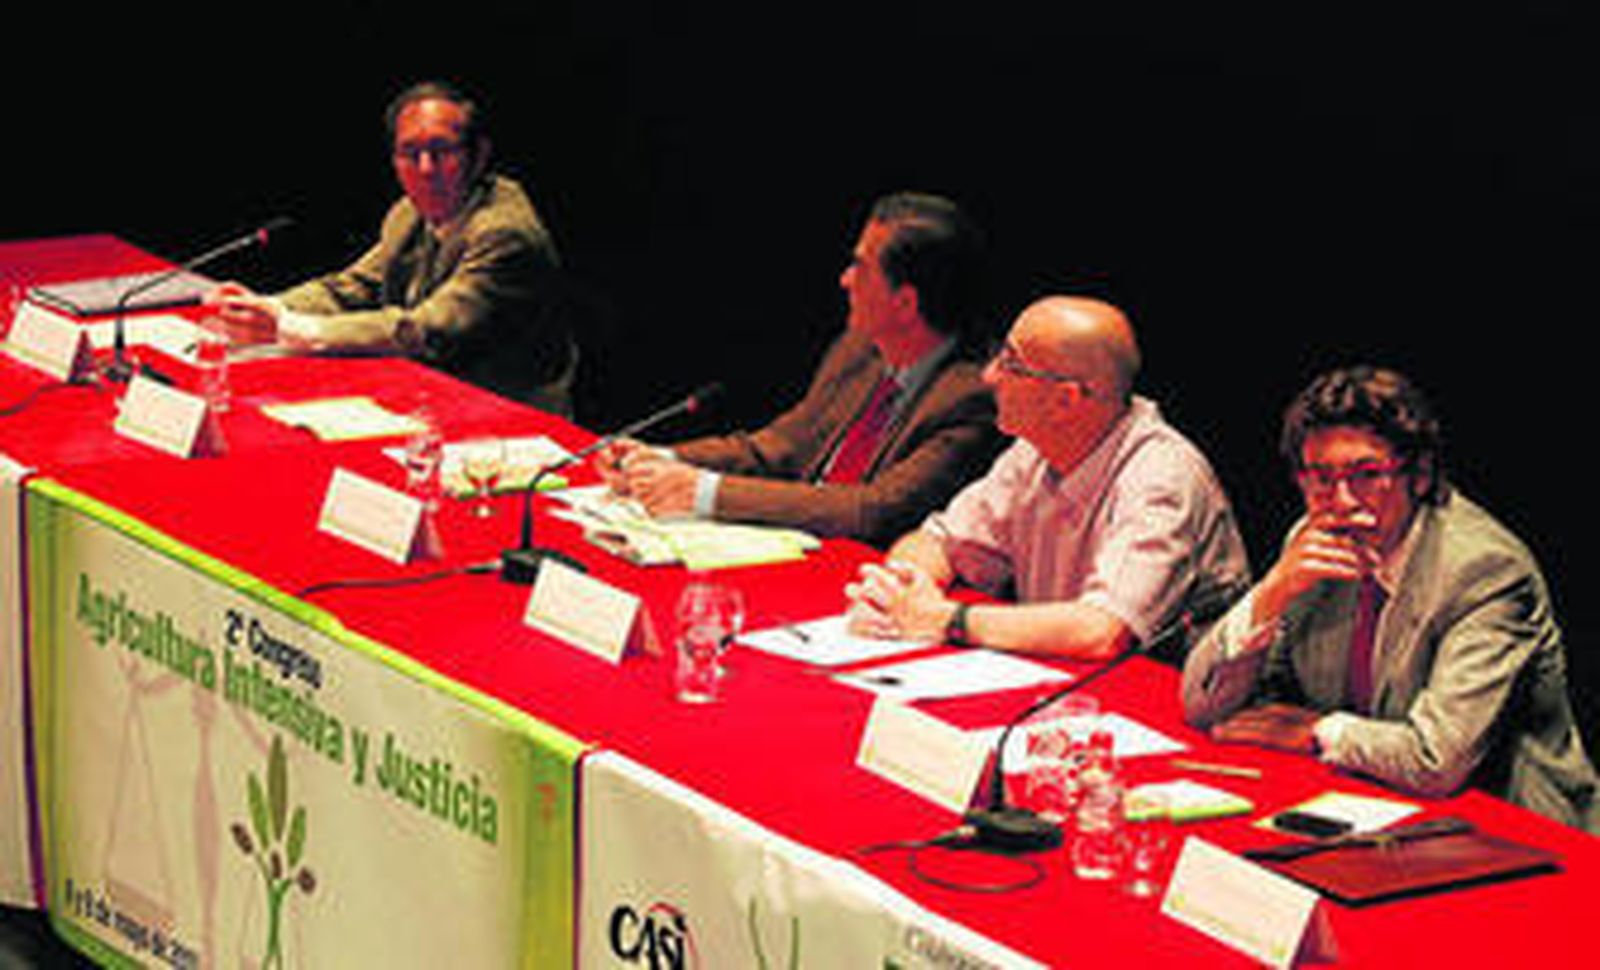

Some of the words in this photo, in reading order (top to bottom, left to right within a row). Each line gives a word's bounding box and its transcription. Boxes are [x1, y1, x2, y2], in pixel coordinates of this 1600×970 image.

[77, 573, 215, 690] Agricultura
[224, 648, 343, 764] Intensiva
[352, 730, 368, 787] y
[376, 731, 497, 845] Justicia
